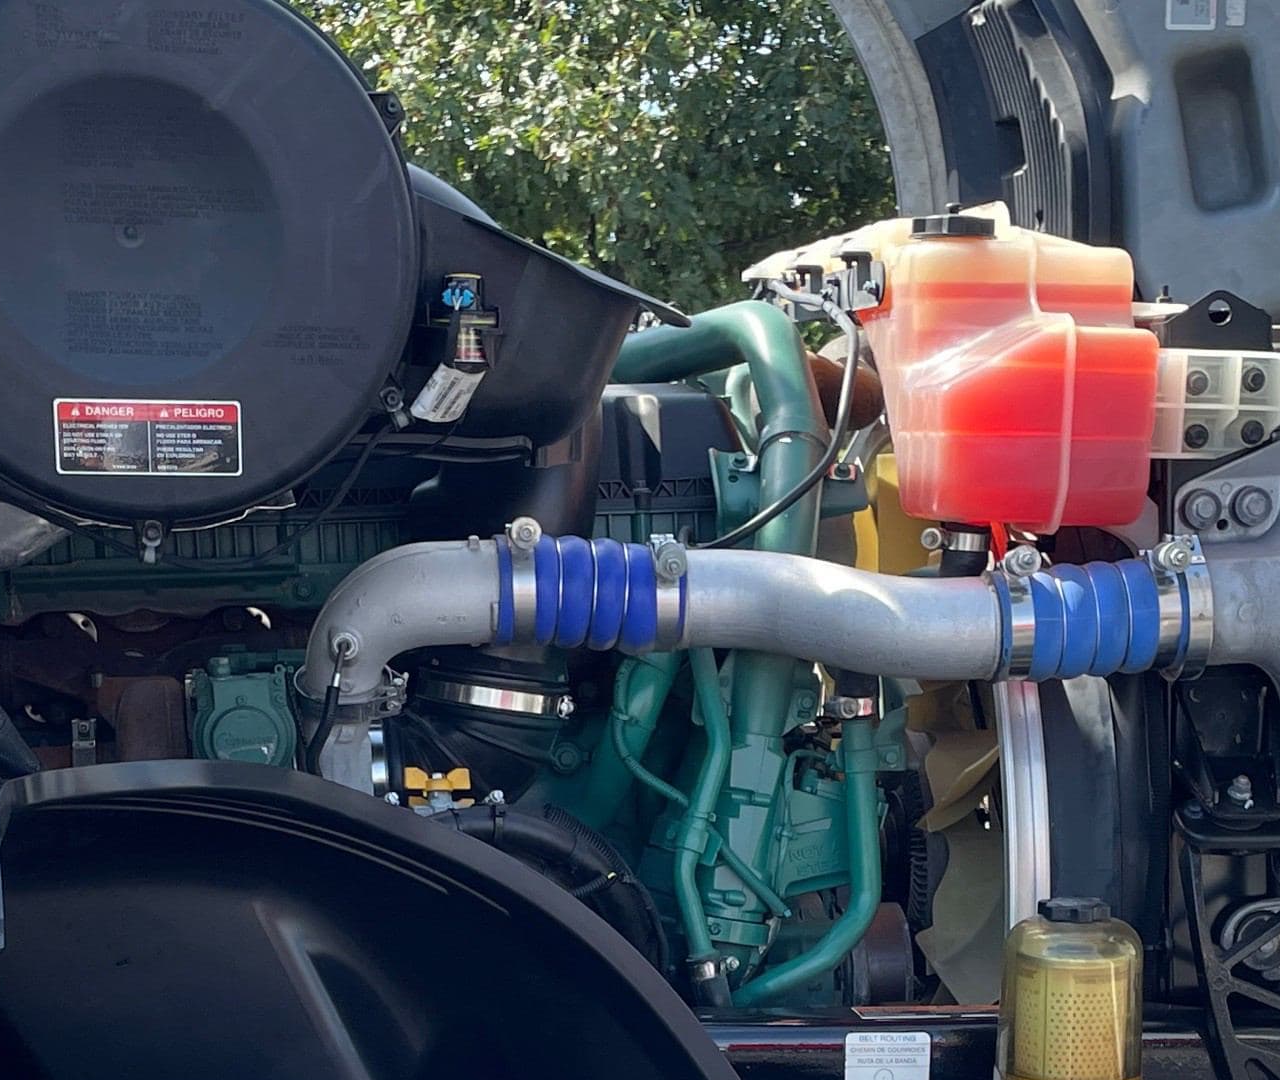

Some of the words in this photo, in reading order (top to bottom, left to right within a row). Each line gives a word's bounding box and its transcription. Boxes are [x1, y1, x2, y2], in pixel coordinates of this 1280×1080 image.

[85, 405, 135, 417] DANGER
[173, 407, 225, 418] PELIGRO
[858, 1034, 878, 1042] BELT
[879, 1034, 917, 1042] ROUTING
